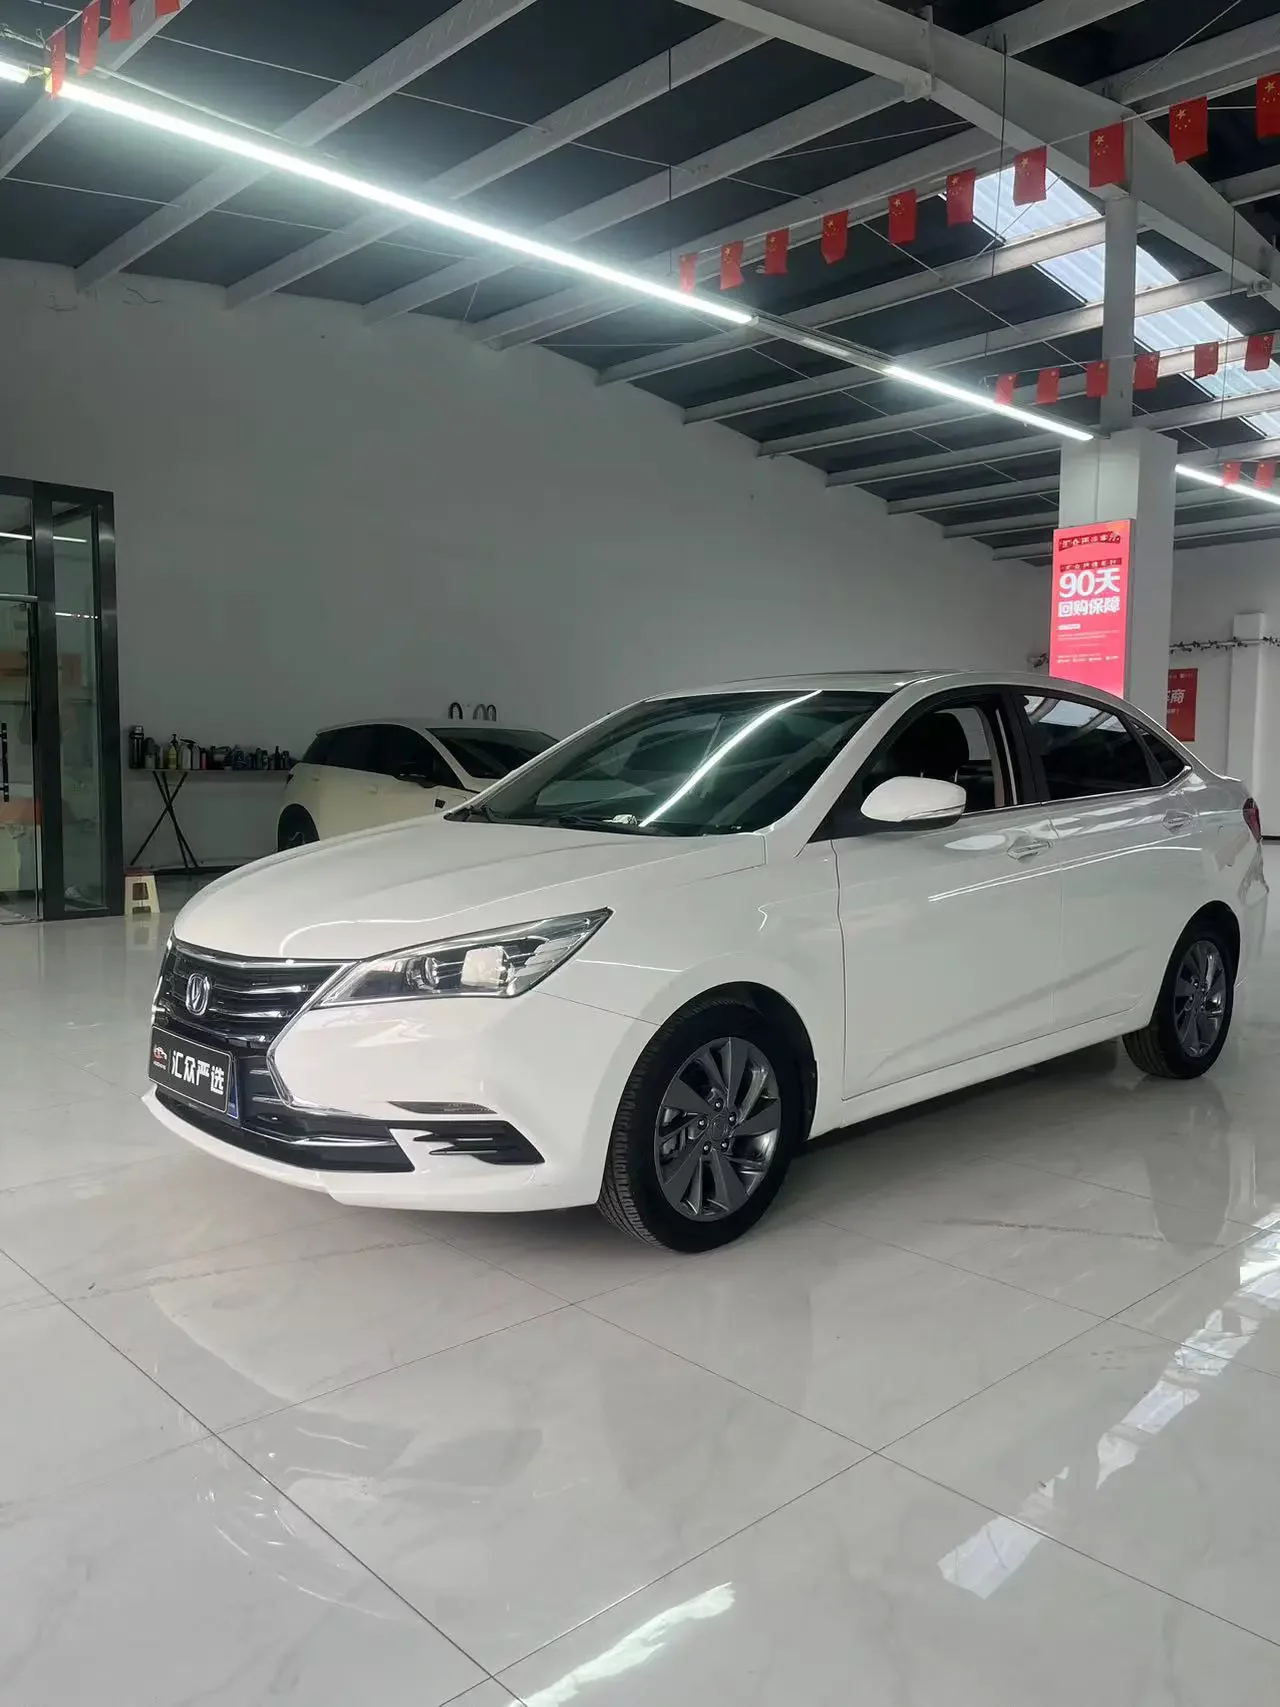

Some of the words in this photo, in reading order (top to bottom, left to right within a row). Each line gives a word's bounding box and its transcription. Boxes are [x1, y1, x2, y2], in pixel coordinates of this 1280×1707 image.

[1059, 568, 1120, 598] 90天
[1058, 596, 1120, 617] 回购保障
[171, 1050, 224, 1095] 汇众严选
